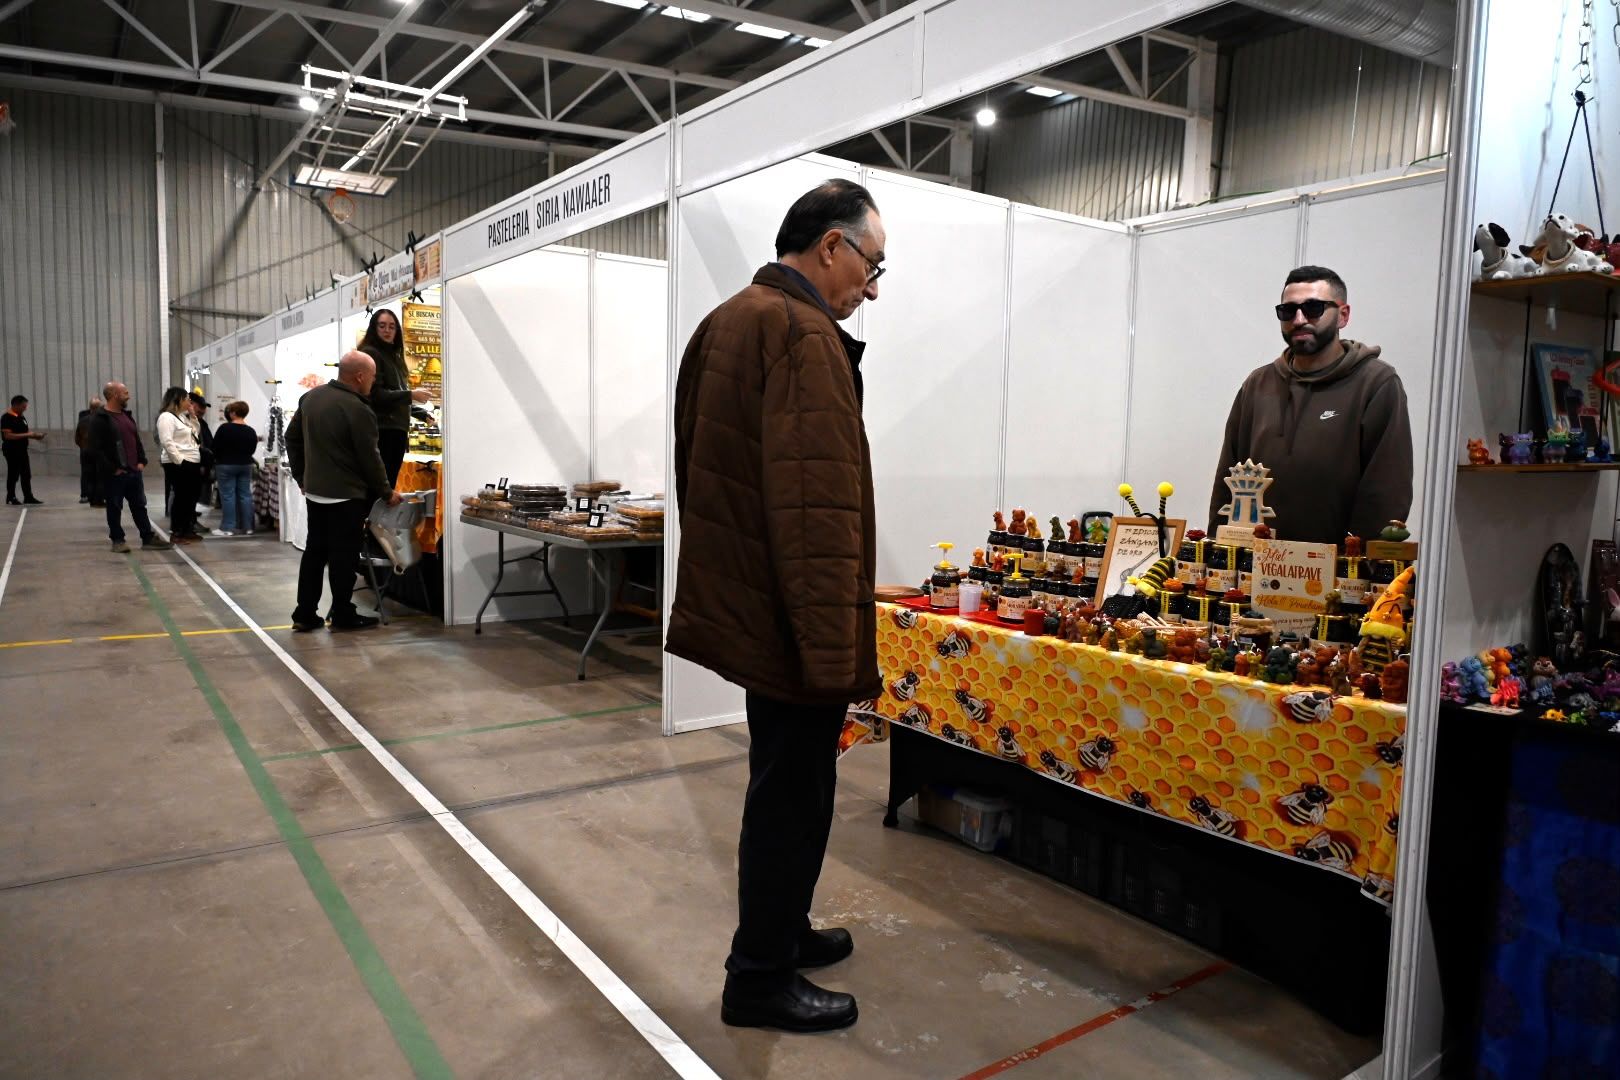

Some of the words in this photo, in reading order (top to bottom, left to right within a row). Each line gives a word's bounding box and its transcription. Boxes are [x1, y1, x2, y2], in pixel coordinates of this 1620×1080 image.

[488, 209, 530, 248] PASTELERIA
[536, 195, 560, 230] SIRIA
[563, 173, 611, 219] NAWAAER
[408, 310, 415, 318] SE
[415, 311, 435, 319] BUSCAN
[415, 345, 426, 354] LA
[427, 345, 441, 354] LLE
[1262, 548, 1288, 563] Miel
